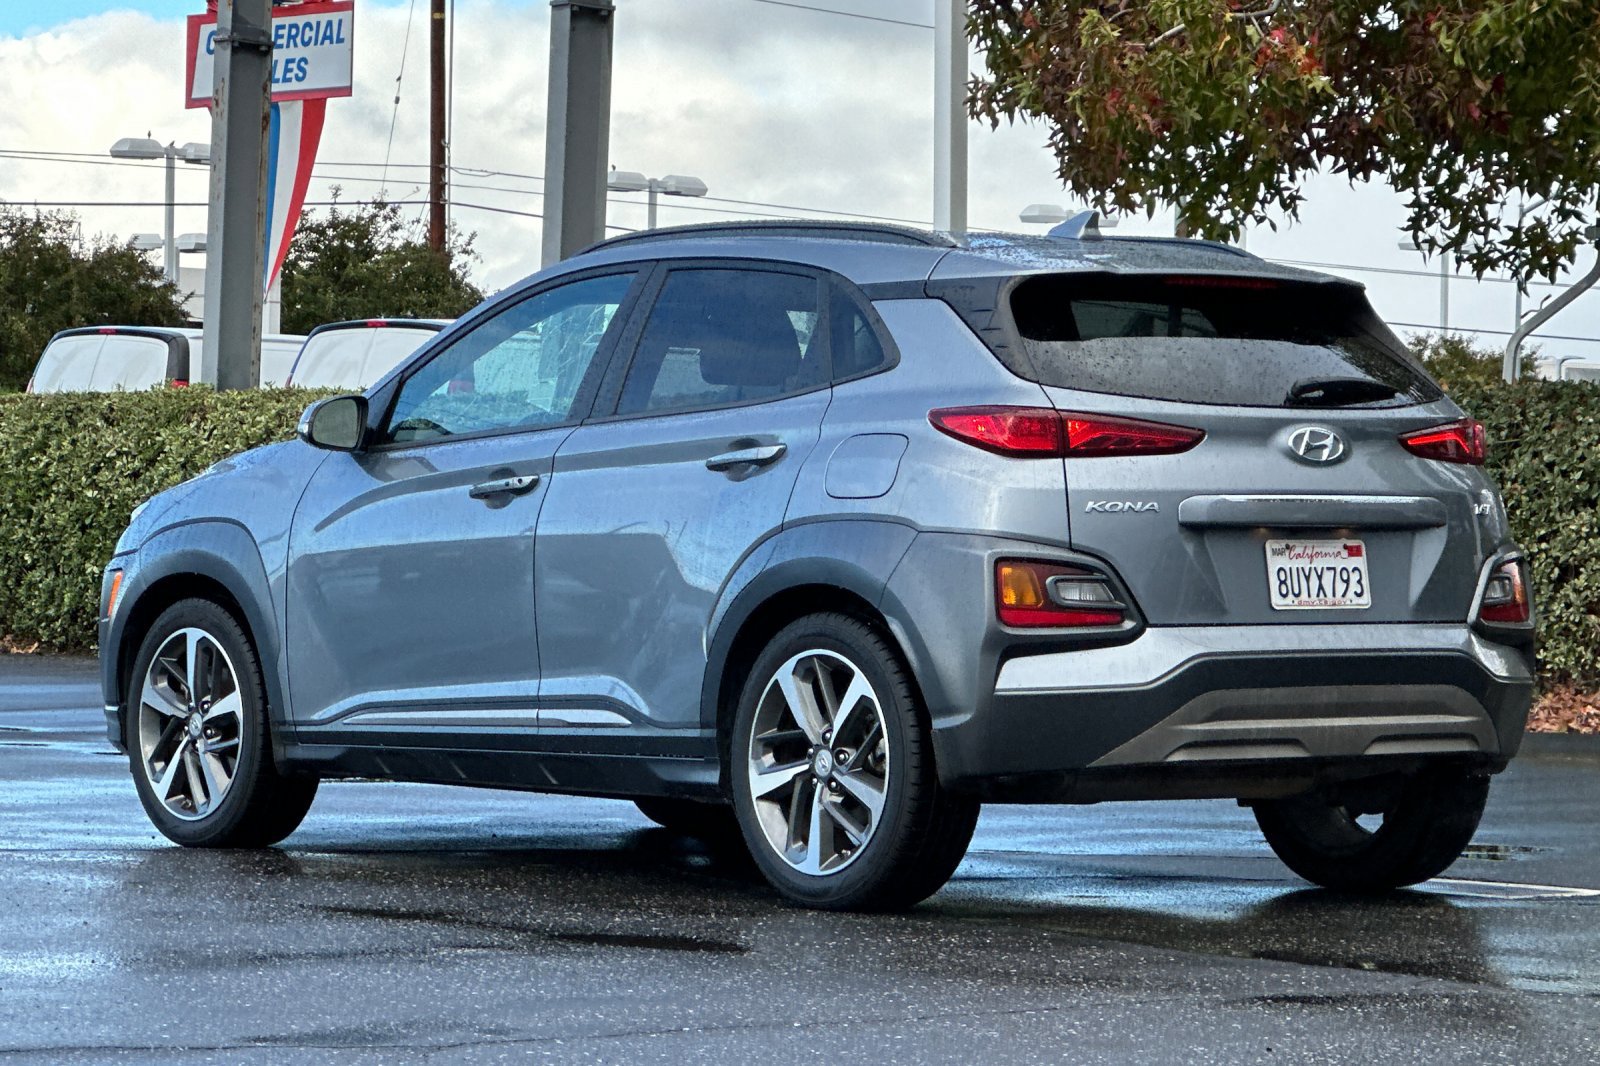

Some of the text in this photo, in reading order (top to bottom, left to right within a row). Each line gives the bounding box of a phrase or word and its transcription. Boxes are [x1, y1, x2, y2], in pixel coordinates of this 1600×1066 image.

[206, 18, 345, 55] CERCIAL
[271, 57, 309, 84] LES
[1085, 500, 1160, 513] KONA
[1271, 547, 1286, 557] MAR
[1288, 544, 1349, 564] California
[1276, 566, 1364, 598] 8UYX793
